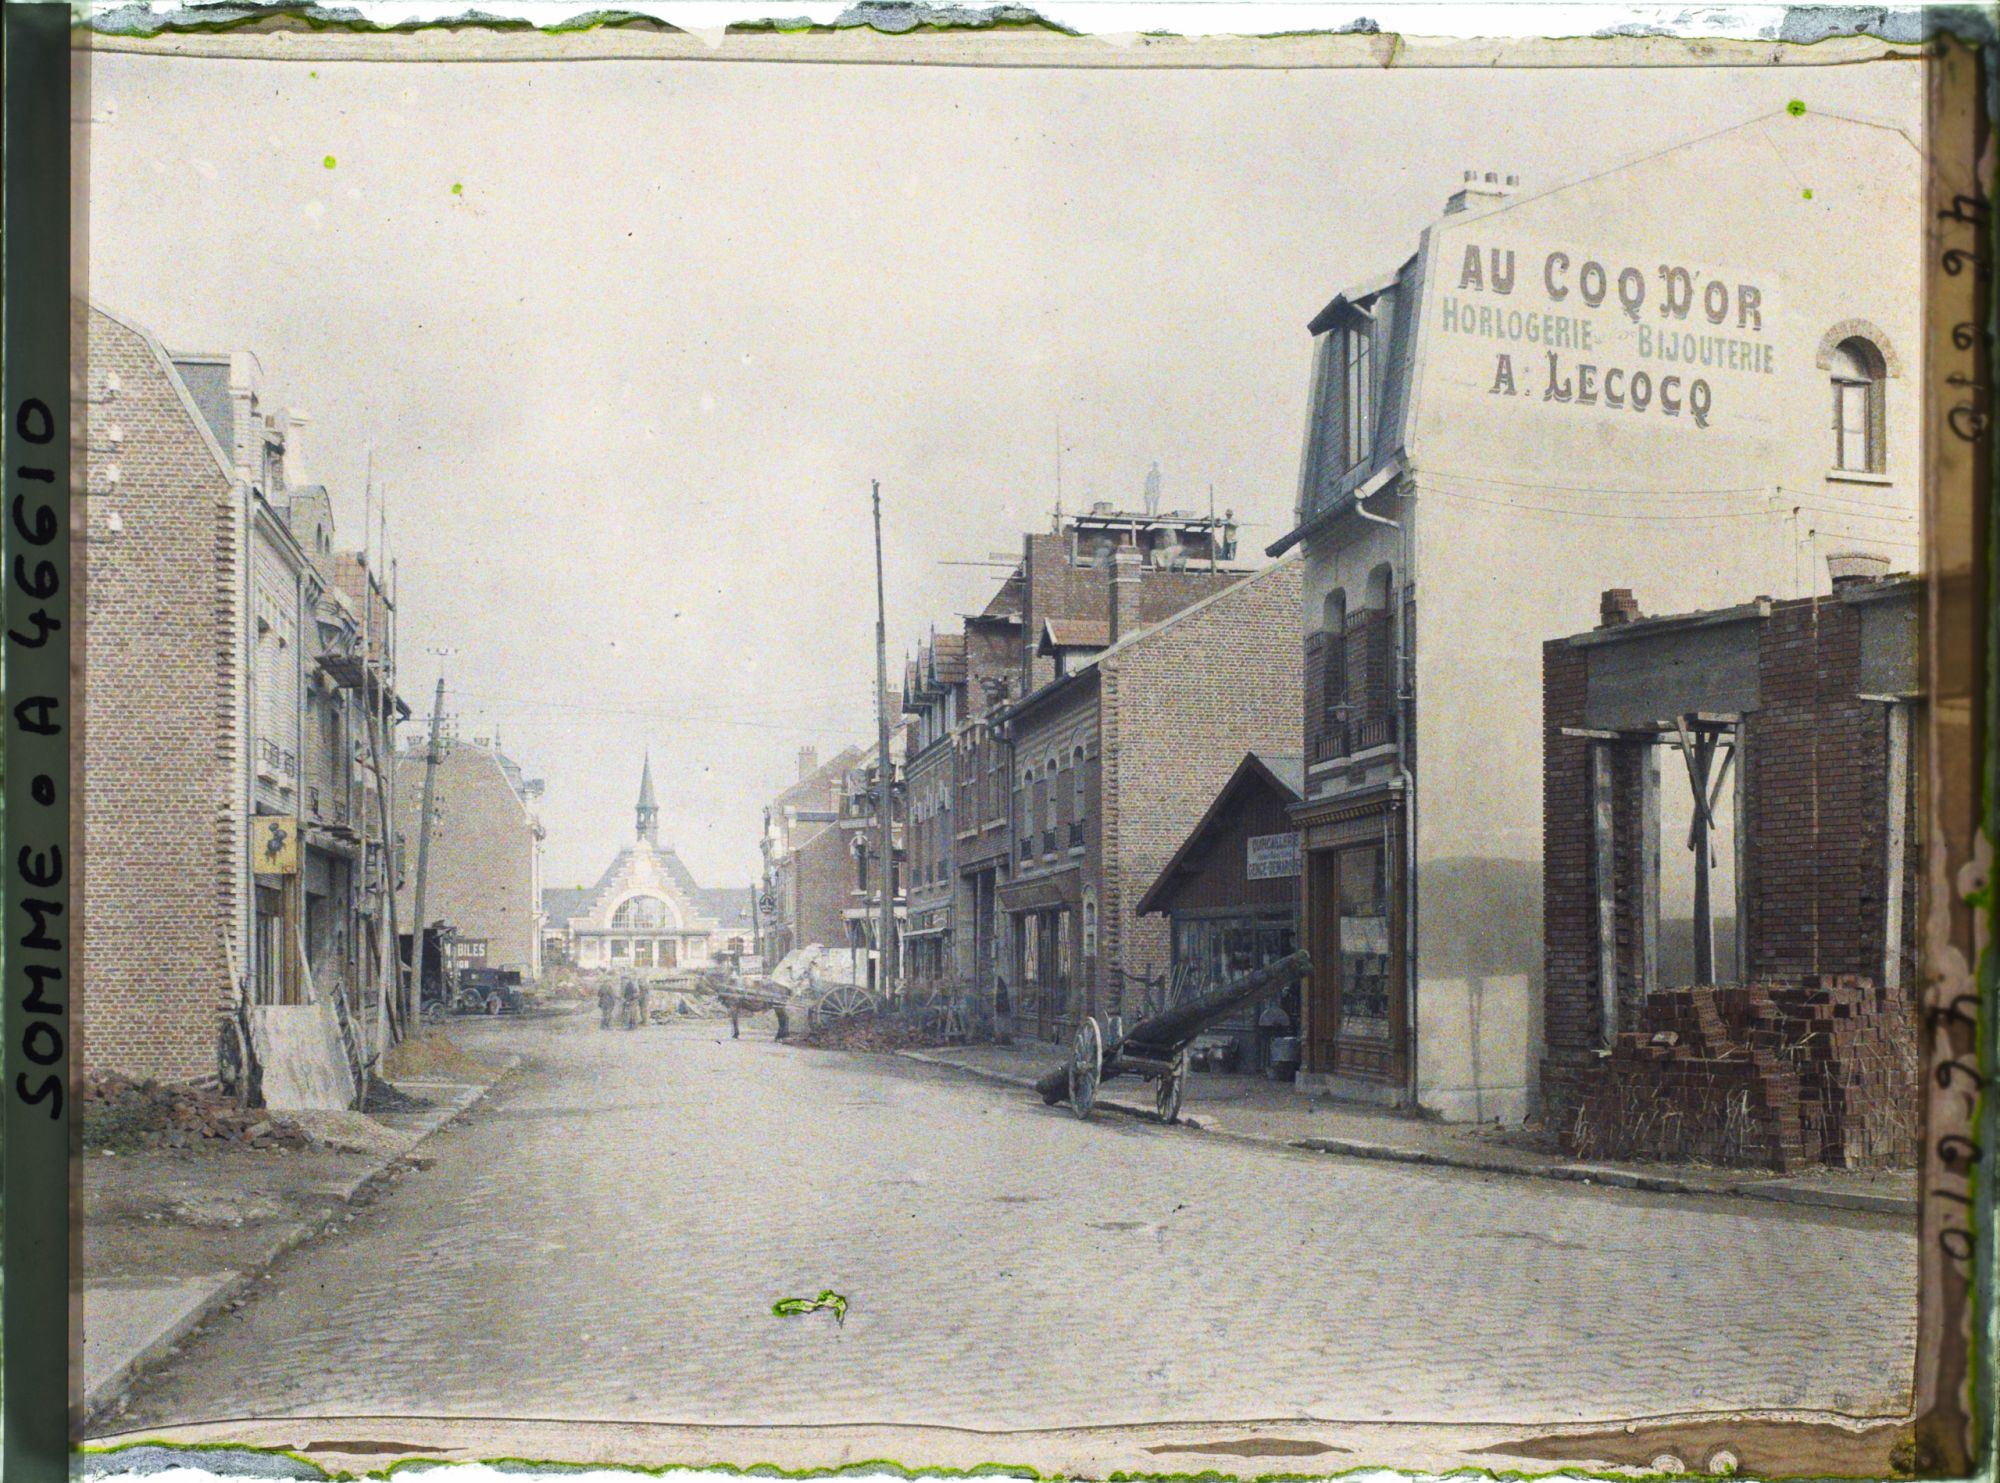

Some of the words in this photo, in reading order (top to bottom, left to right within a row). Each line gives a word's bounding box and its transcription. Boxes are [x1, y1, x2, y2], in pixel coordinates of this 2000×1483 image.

[1458, 244, 1515, 295] AU
[1544, 251, 1646, 323] COQ
[1659, 264, 1762, 331] D'OR
[1442, 297, 1593, 351] HORLOGERIE
[1638, 323, 1774, 374] BIJOUTERIE
[1543, 350, 1711, 429] LECOCQ
[8, 398, 61, 648] 46610
[14, 696, 61, 735] A
[16, 845, 63, 1120] SOMME
